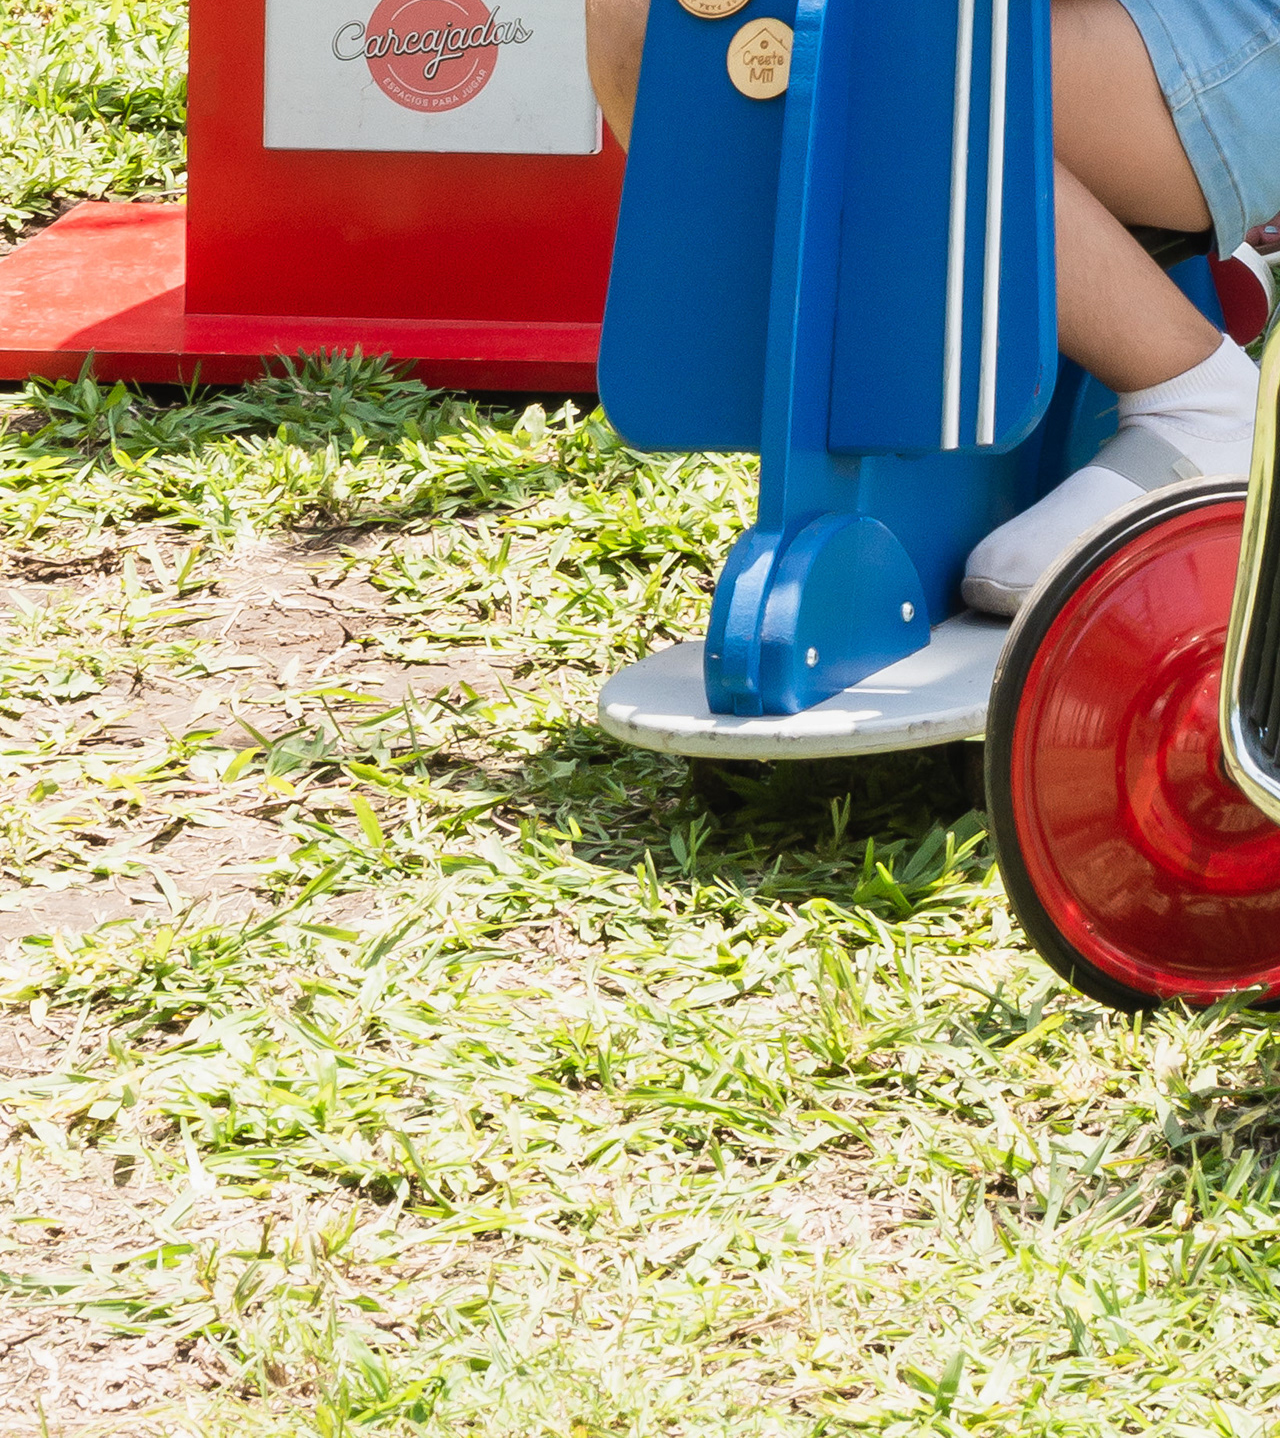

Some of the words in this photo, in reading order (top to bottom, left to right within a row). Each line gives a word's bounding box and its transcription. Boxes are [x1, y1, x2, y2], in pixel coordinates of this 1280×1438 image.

[332, 5, 534, 79] Carcajadas
[382, 77, 430, 108] ESPACIOS
[432, 94, 460, 107] PARA
[462, 69, 488, 98] JUGAR
